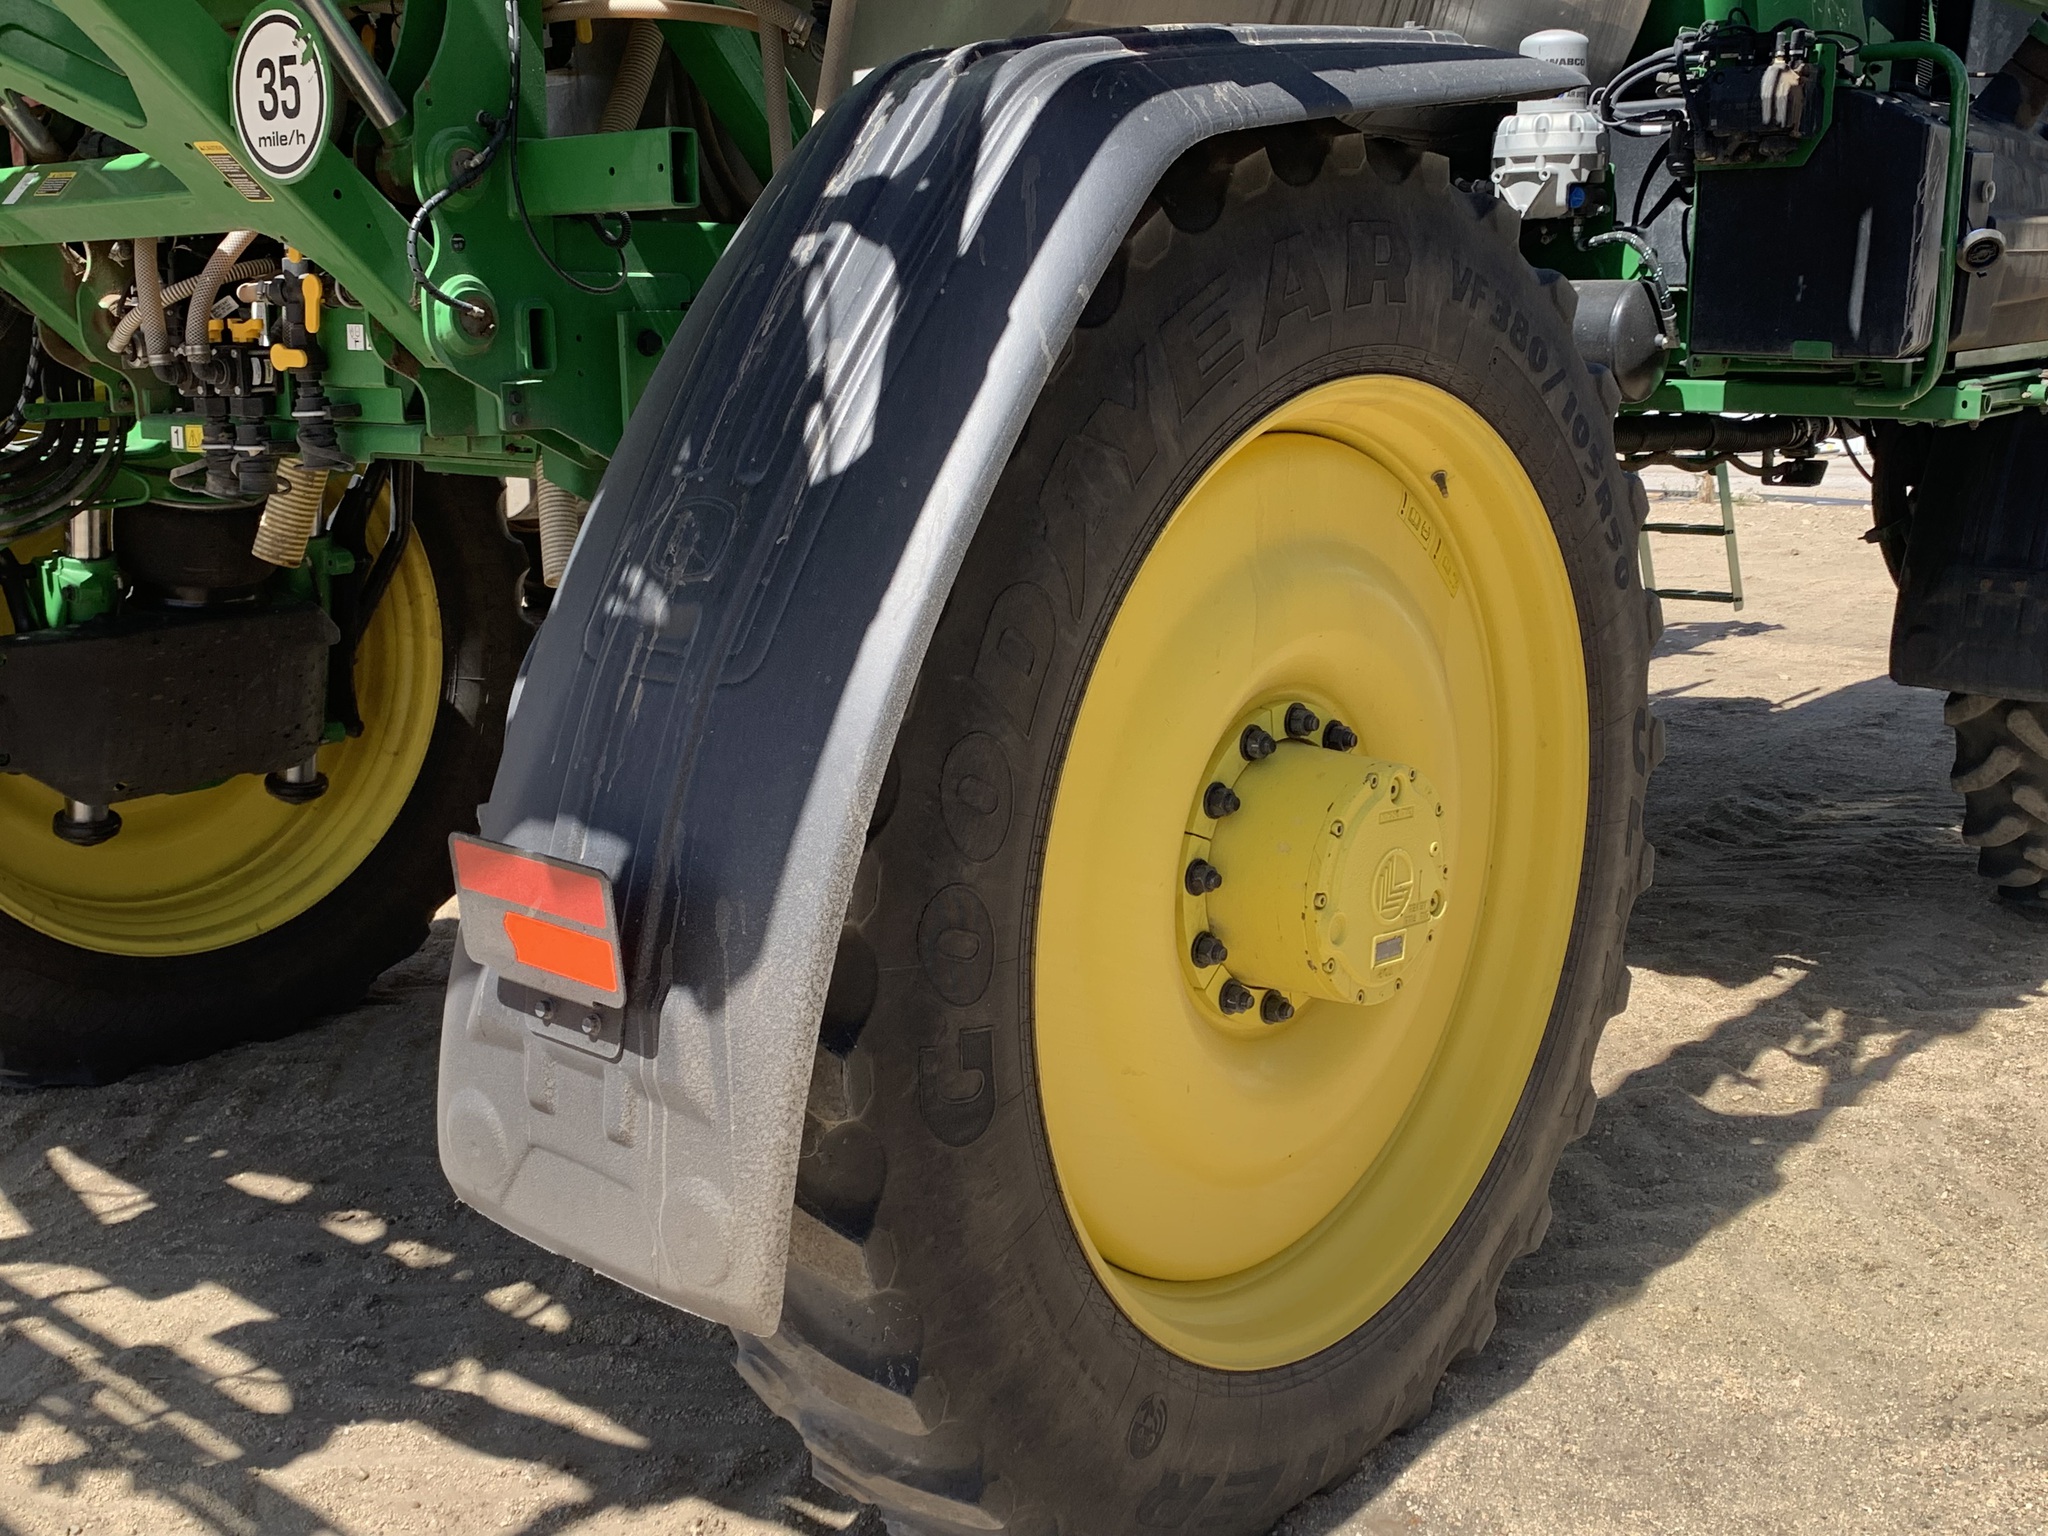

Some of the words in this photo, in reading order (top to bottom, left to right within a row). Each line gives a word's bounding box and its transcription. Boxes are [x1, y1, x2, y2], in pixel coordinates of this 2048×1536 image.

[256, 54, 301, 121] 35
[258, 129, 306, 147] mile/h
[173, 428, 180, 446] 1
